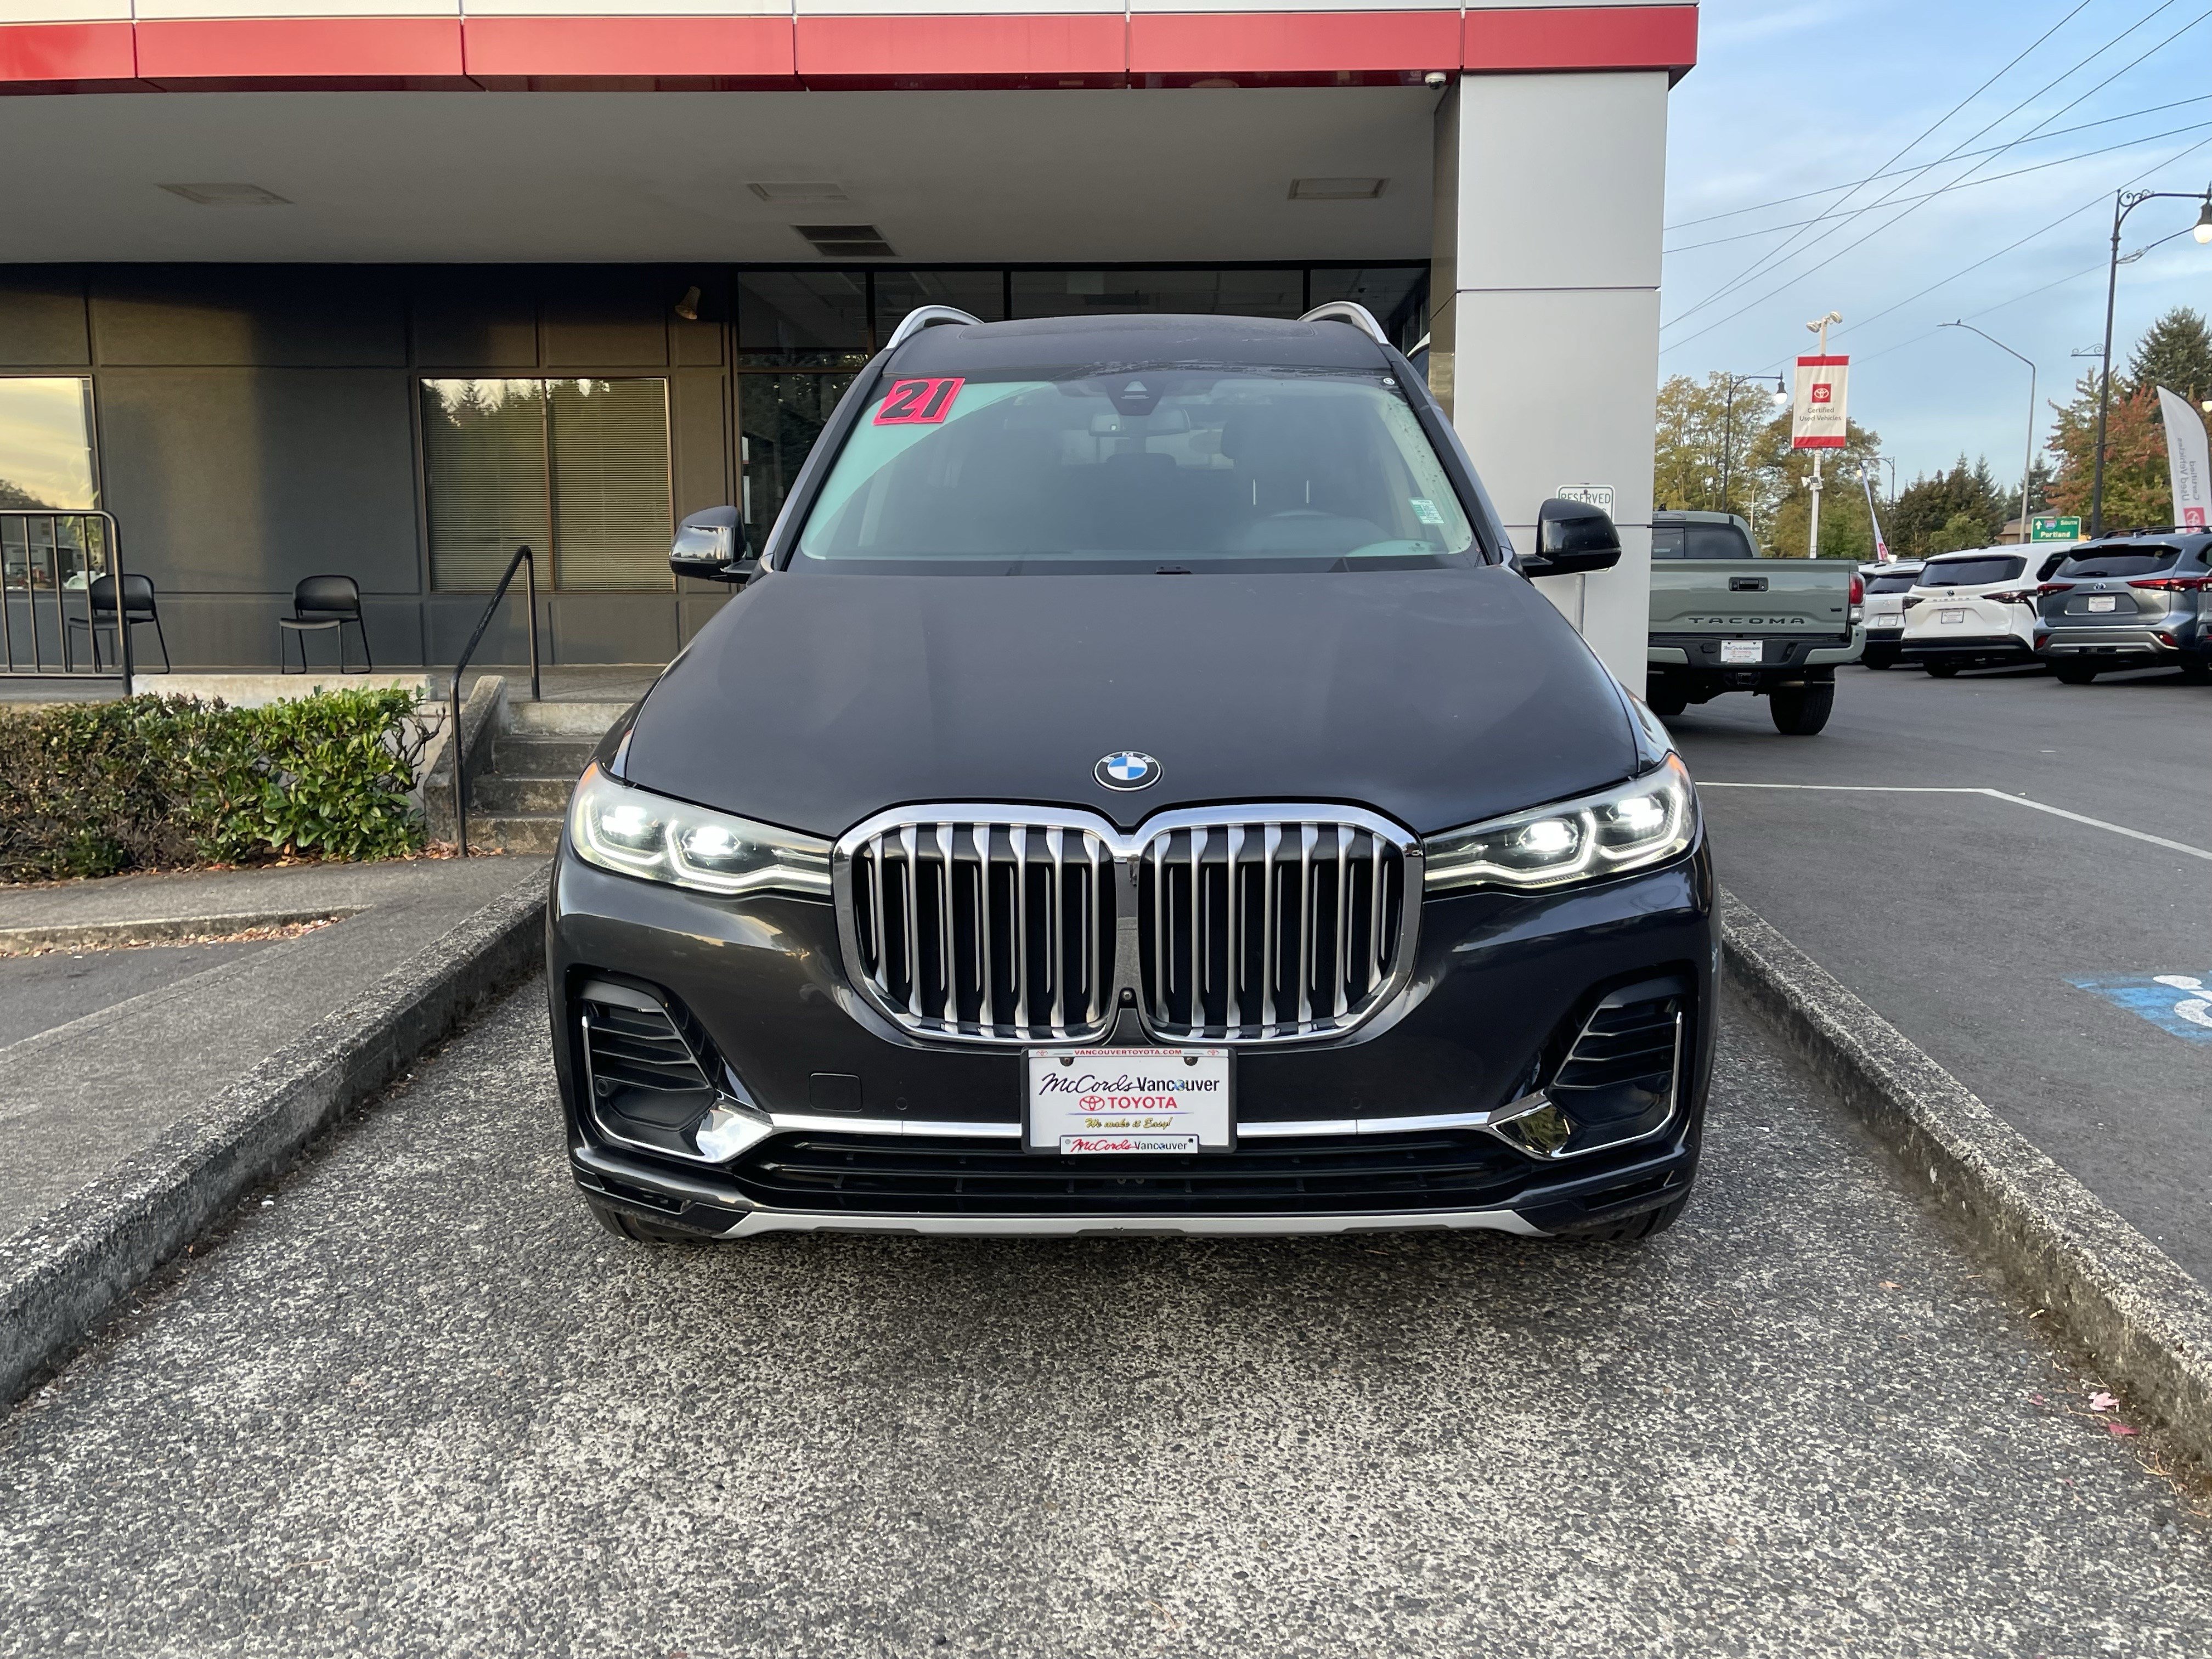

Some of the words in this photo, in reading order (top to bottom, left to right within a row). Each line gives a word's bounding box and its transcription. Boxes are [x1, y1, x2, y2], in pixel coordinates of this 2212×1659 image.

[879, 381, 955, 418] 21
[1560, 493, 1611, 504] RESERVED
[1102, 751, 1155, 763] BMW
[1039, 1073, 1136, 1096] McCords
[1136, 1076, 1220, 1092] Vancouver
[1108, 1097, 1178, 1109] TOYOTA
[1085, 1118, 1102, 1128] We
[1104, 1118, 1130, 1128] make
[1132, 1119, 1141, 1128] it
[1143, 1116, 1173, 1130] Easy!
[1134, 1141, 1188, 1150] Vancouver
